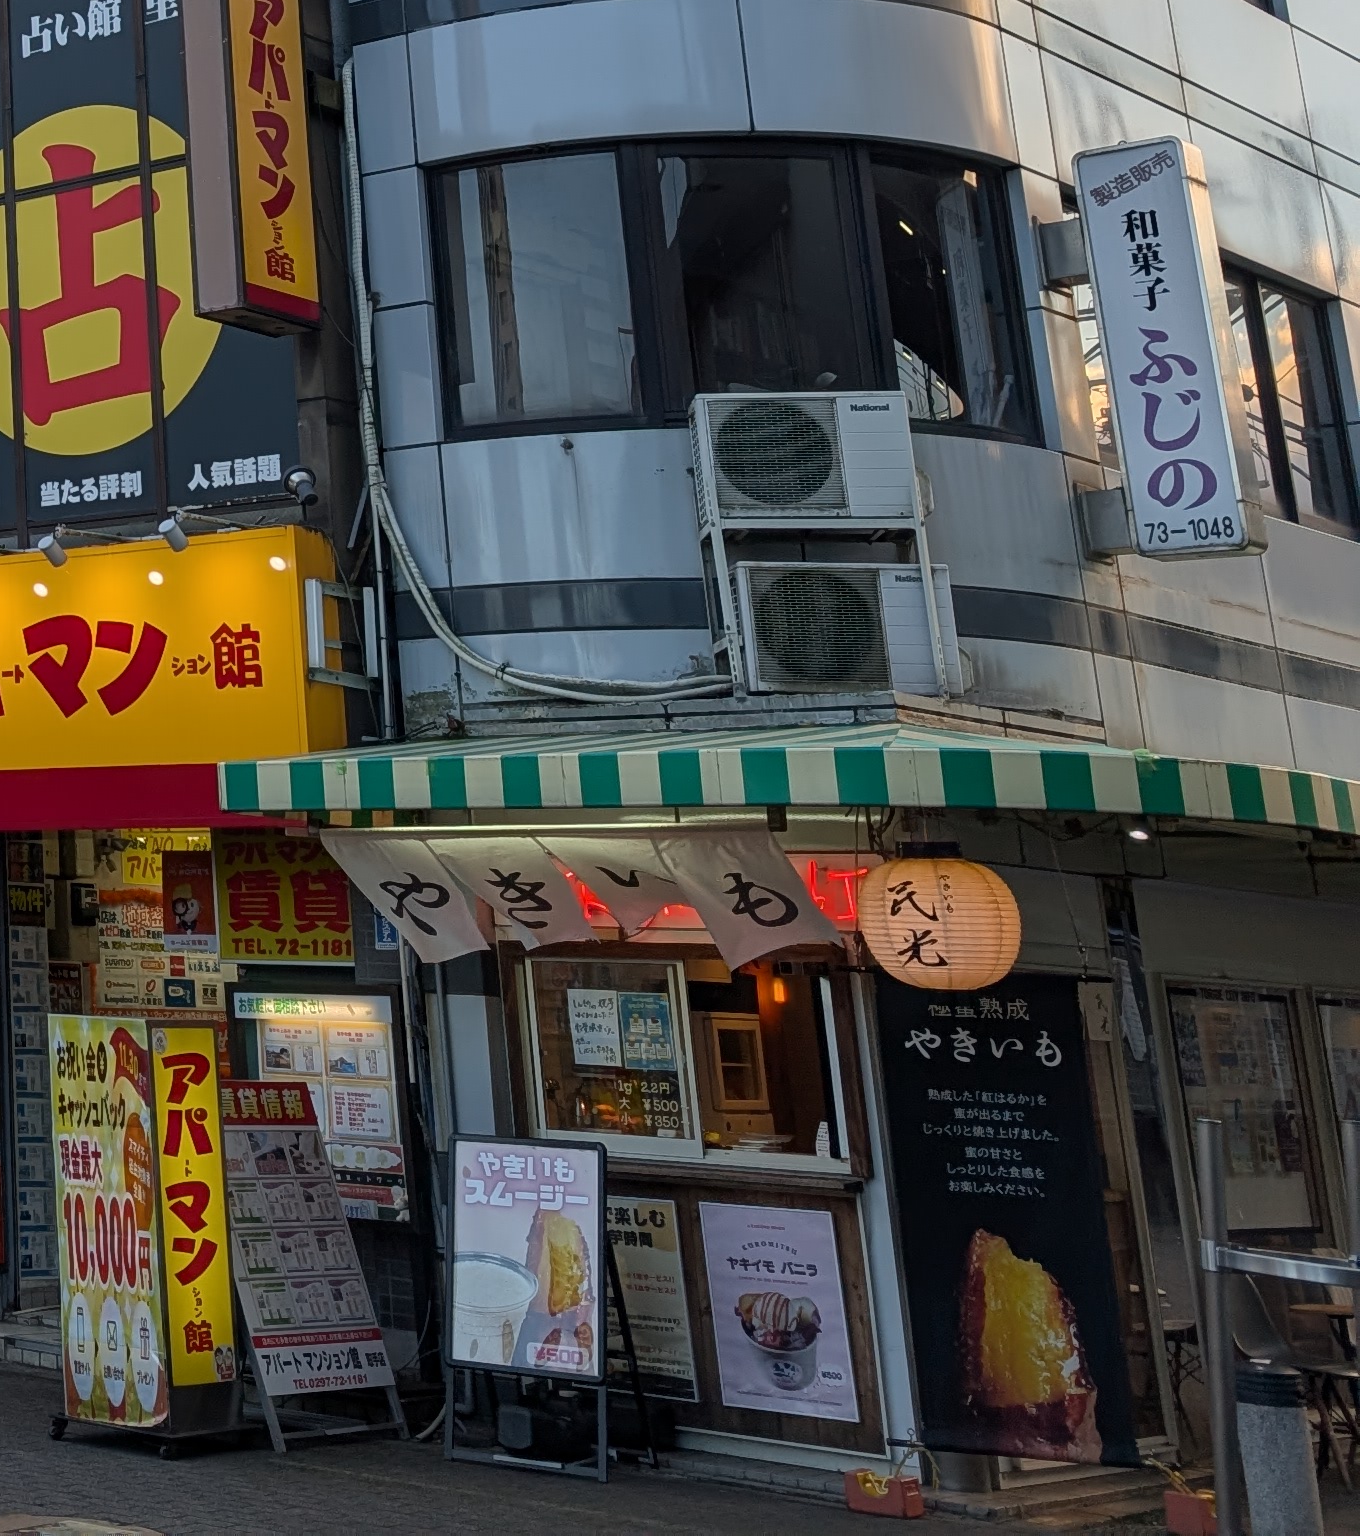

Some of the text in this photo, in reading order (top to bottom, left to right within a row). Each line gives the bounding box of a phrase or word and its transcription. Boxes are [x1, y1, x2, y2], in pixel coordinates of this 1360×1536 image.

[1088, 149, 1177, 209] 製造販売
[1121, 208, 1171, 313] 和菓子
[1128, 326, 1218, 511] ふじの
[40, 470, 143, 509] 当たる評判
[187, 453, 282, 492] 人気話題
[1143, 515, 1236, 545] 73-1048
[226, 868, 352, 934] 賃貸
[904, 1026, 1063, 1067] やきいも
[478, 1151, 576, 1184] やきいも
[464, 1178, 590, 1212] スムージー
